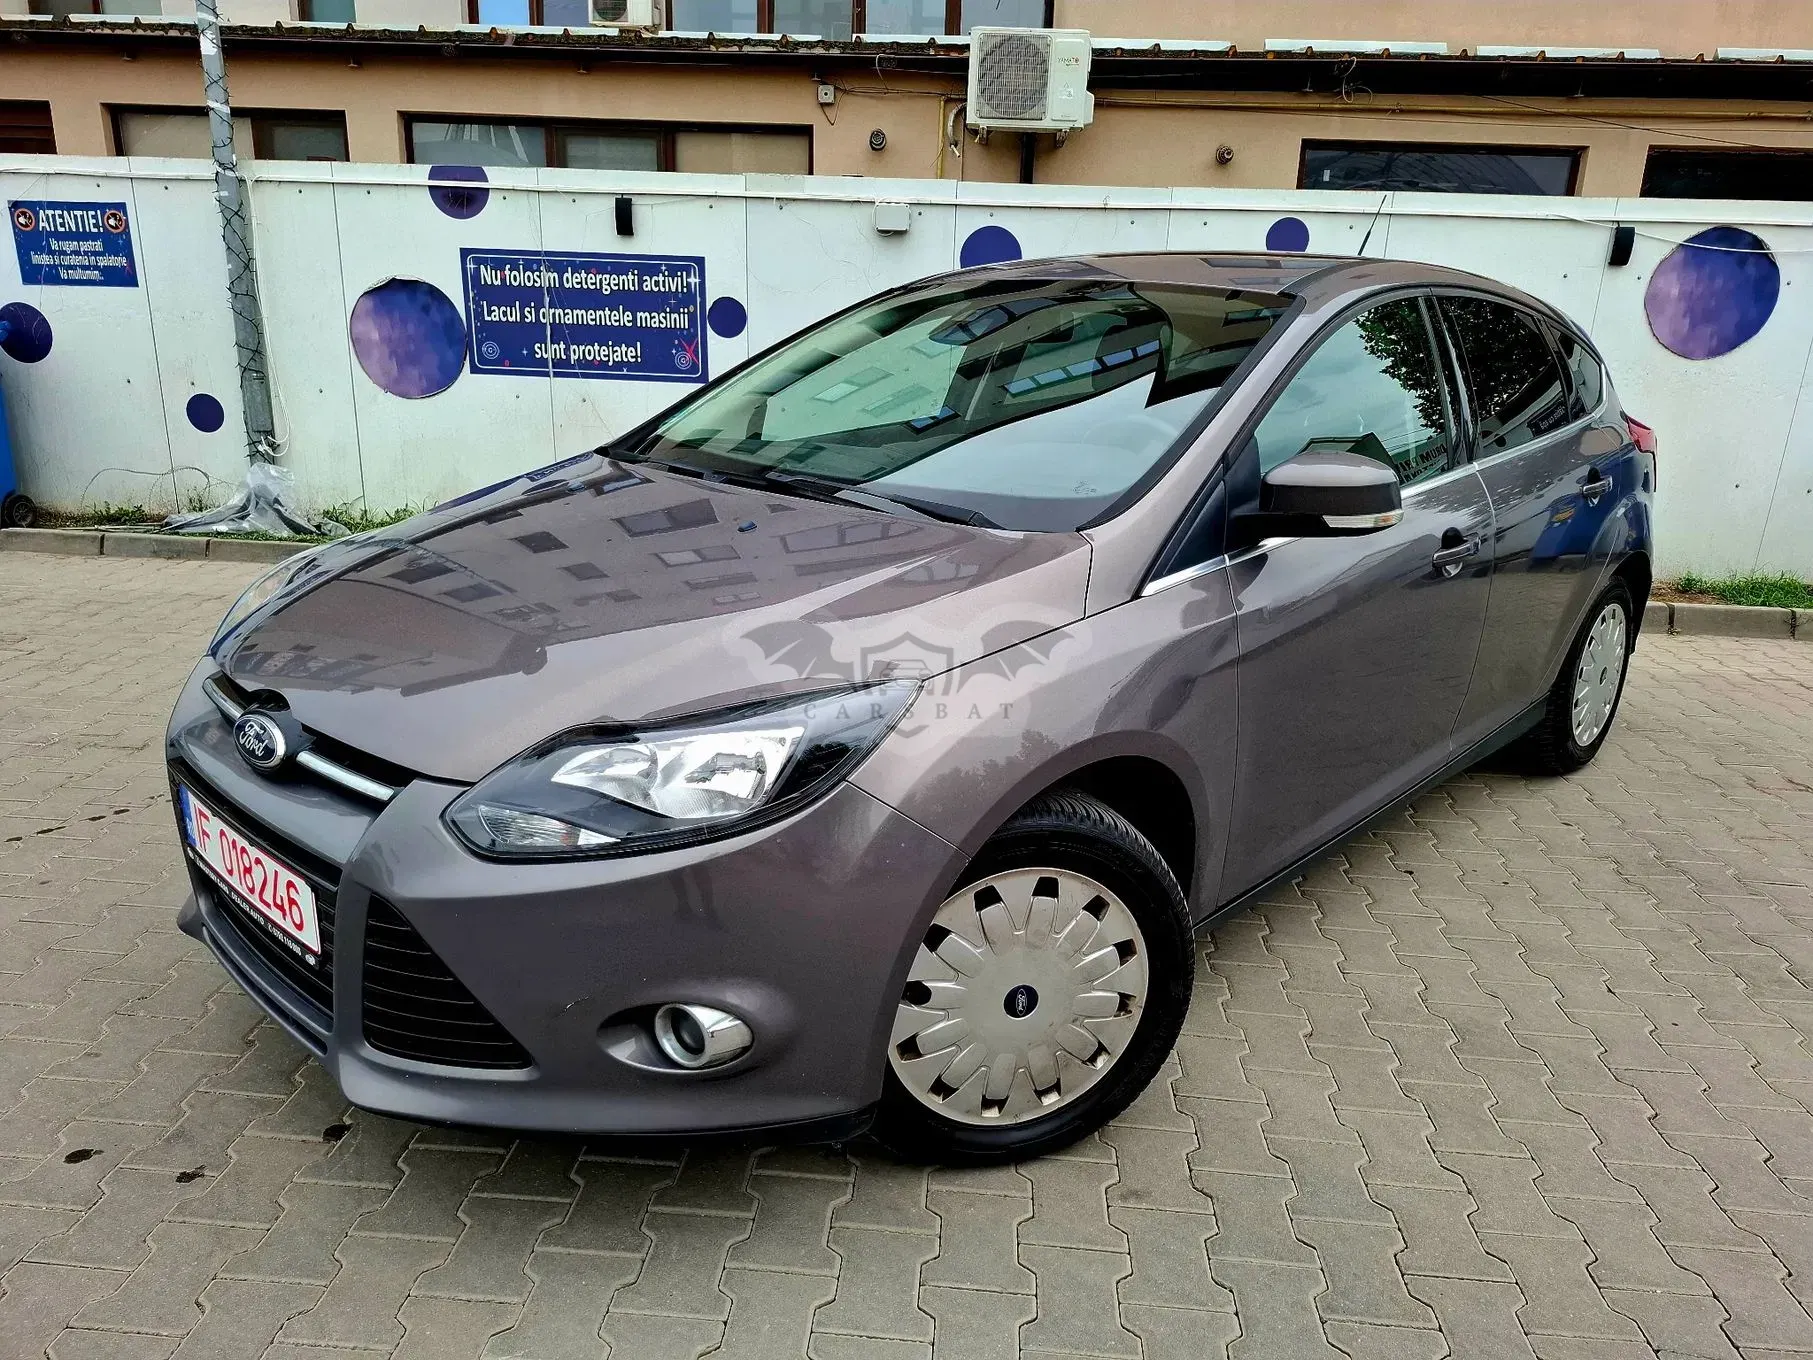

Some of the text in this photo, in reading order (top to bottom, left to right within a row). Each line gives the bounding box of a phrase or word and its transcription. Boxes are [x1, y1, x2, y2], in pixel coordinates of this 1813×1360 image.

[39, 209, 104, 233] ATENTIE!
[49, 237, 104, 255] Va rugam pastrati
[58, 266, 68, 280] Va
[480, 264, 687, 295] Nu folosim detergenti activi!
[482, 300, 689, 329] Lacul si ornamentele masinii
[534, 340, 642, 366] sunt protejate!
[239, 721, 269, 757] Ford
[193, 802, 305, 932] IF 018246
